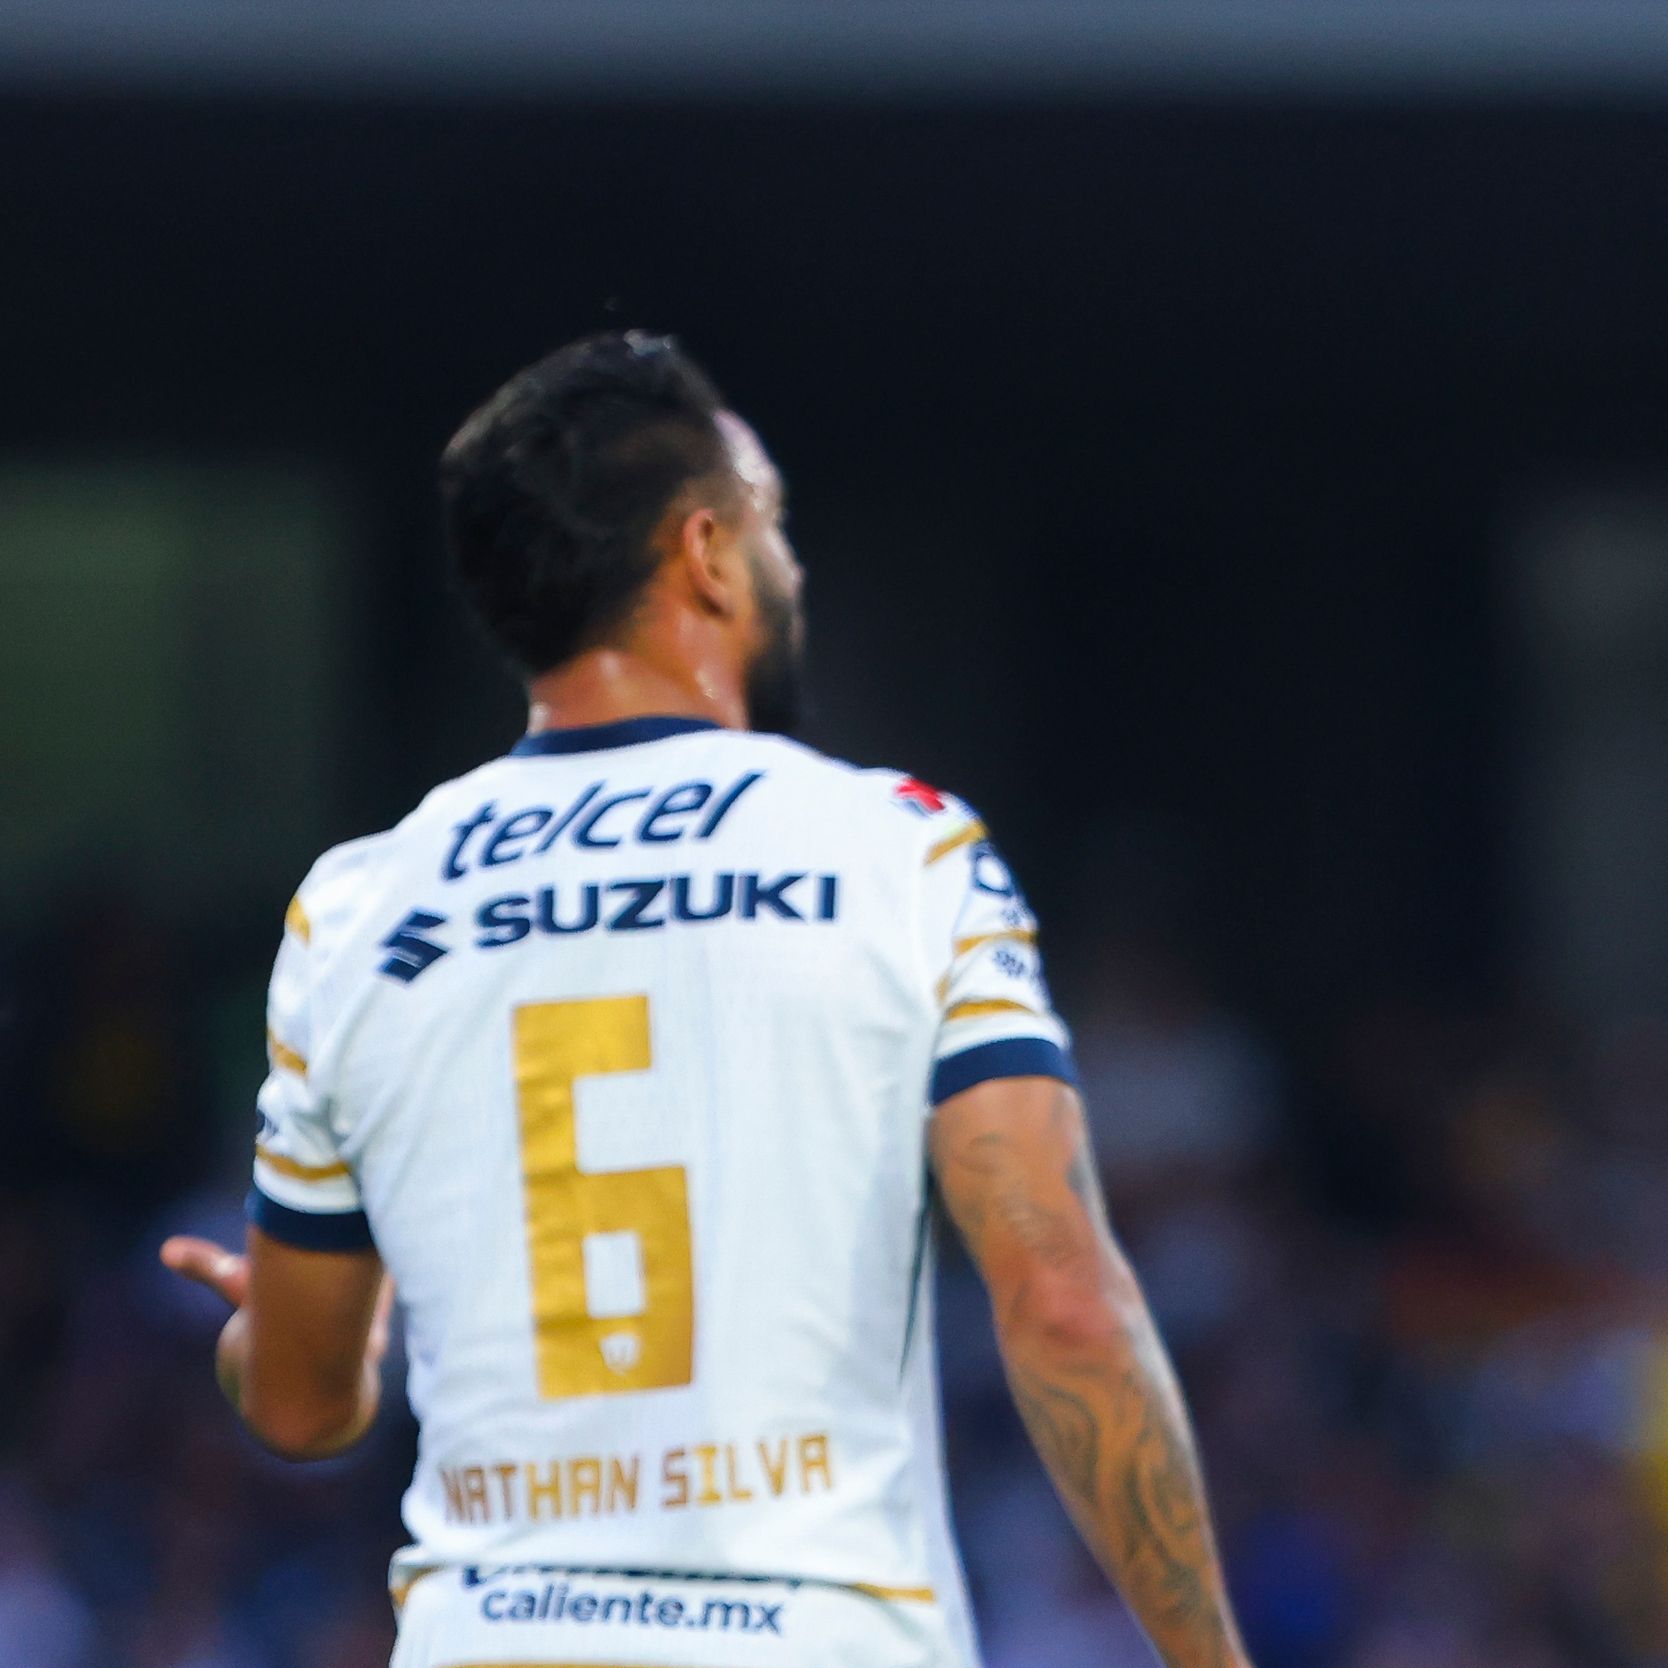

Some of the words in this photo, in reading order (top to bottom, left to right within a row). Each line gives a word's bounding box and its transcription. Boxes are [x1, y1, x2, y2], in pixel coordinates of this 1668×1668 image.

[442, 769, 766, 881] telcel
[475, 872, 839, 949] SUZUKI
[513, 994, 695, 1398] 6
[440, 1455, 640, 1523] NATHAN
[661, 1433, 833, 1509] SILVA
[481, 1580, 784, 1634] caliente.mx
